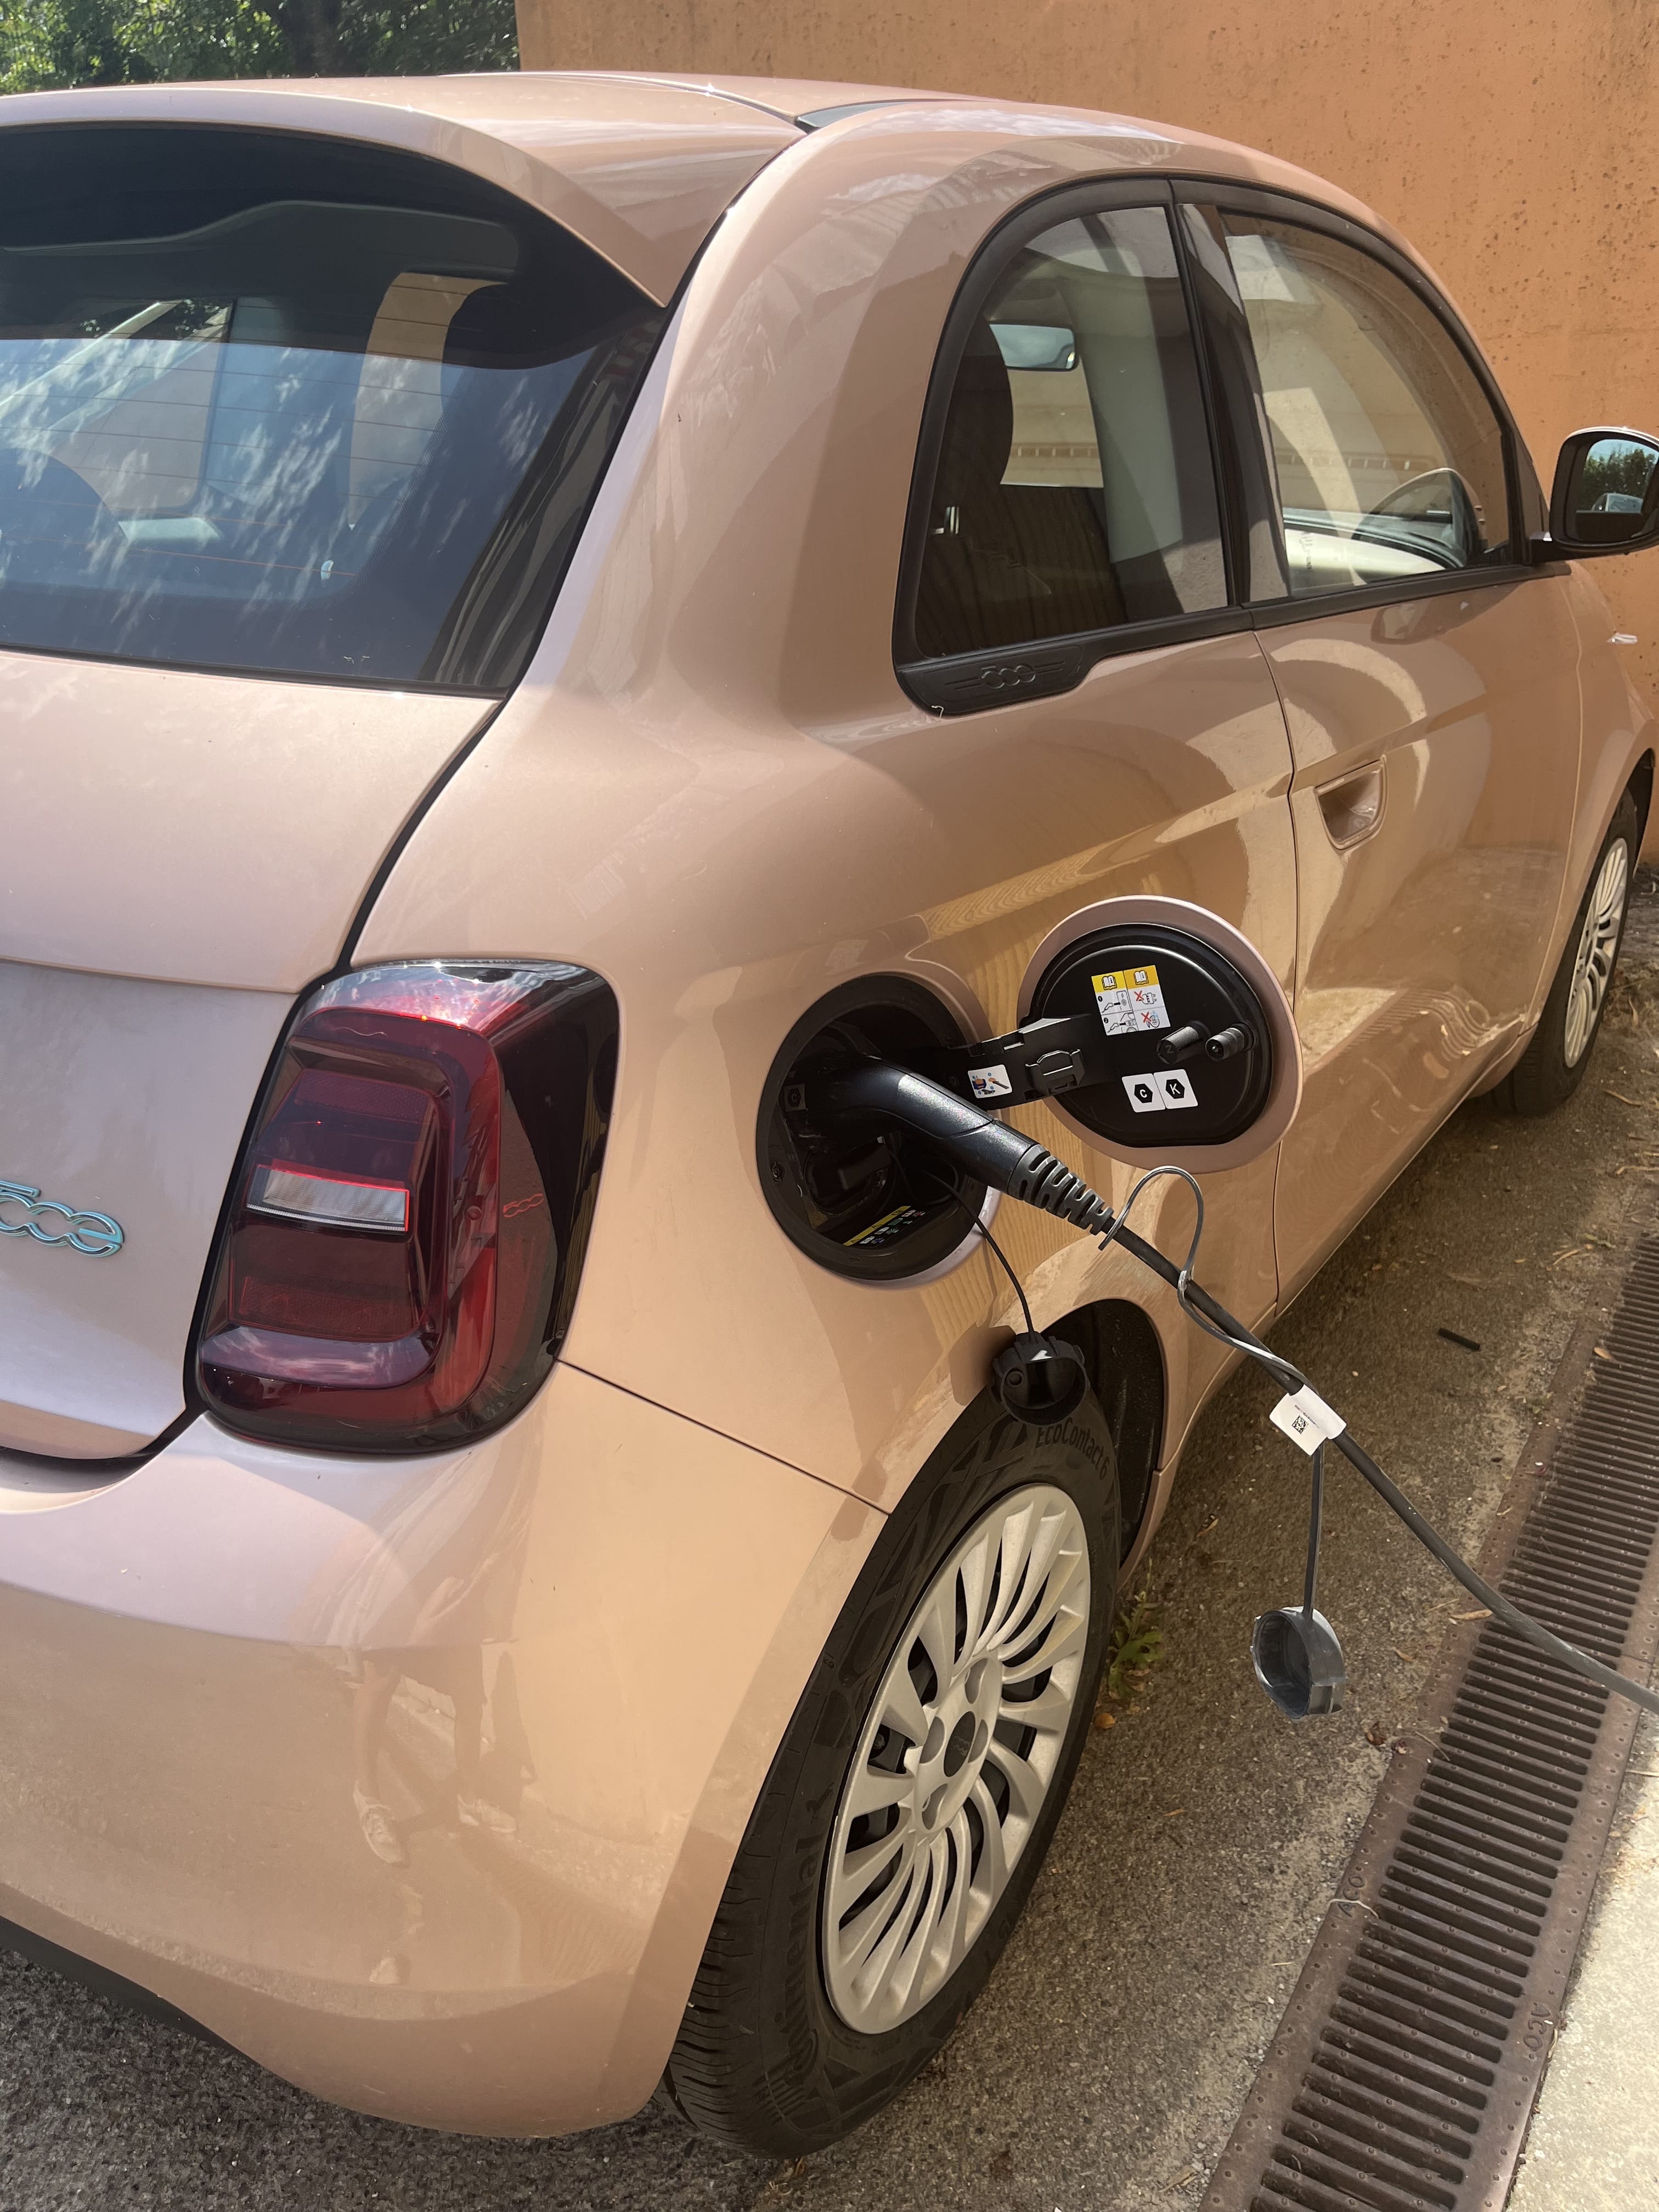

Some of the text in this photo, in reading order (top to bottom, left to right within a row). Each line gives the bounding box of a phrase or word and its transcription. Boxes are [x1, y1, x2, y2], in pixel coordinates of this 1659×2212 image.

[981, 664, 1036, 690] 500
[1139, 1088, 1148, 1098] C
[1169, 1083, 1181, 1095] K
[502, 1193, 545, 1218] 500
[1035, 1417, 1110, 1481] EcoContact 6
[1523, 2002, 1551, 2052] ACO
